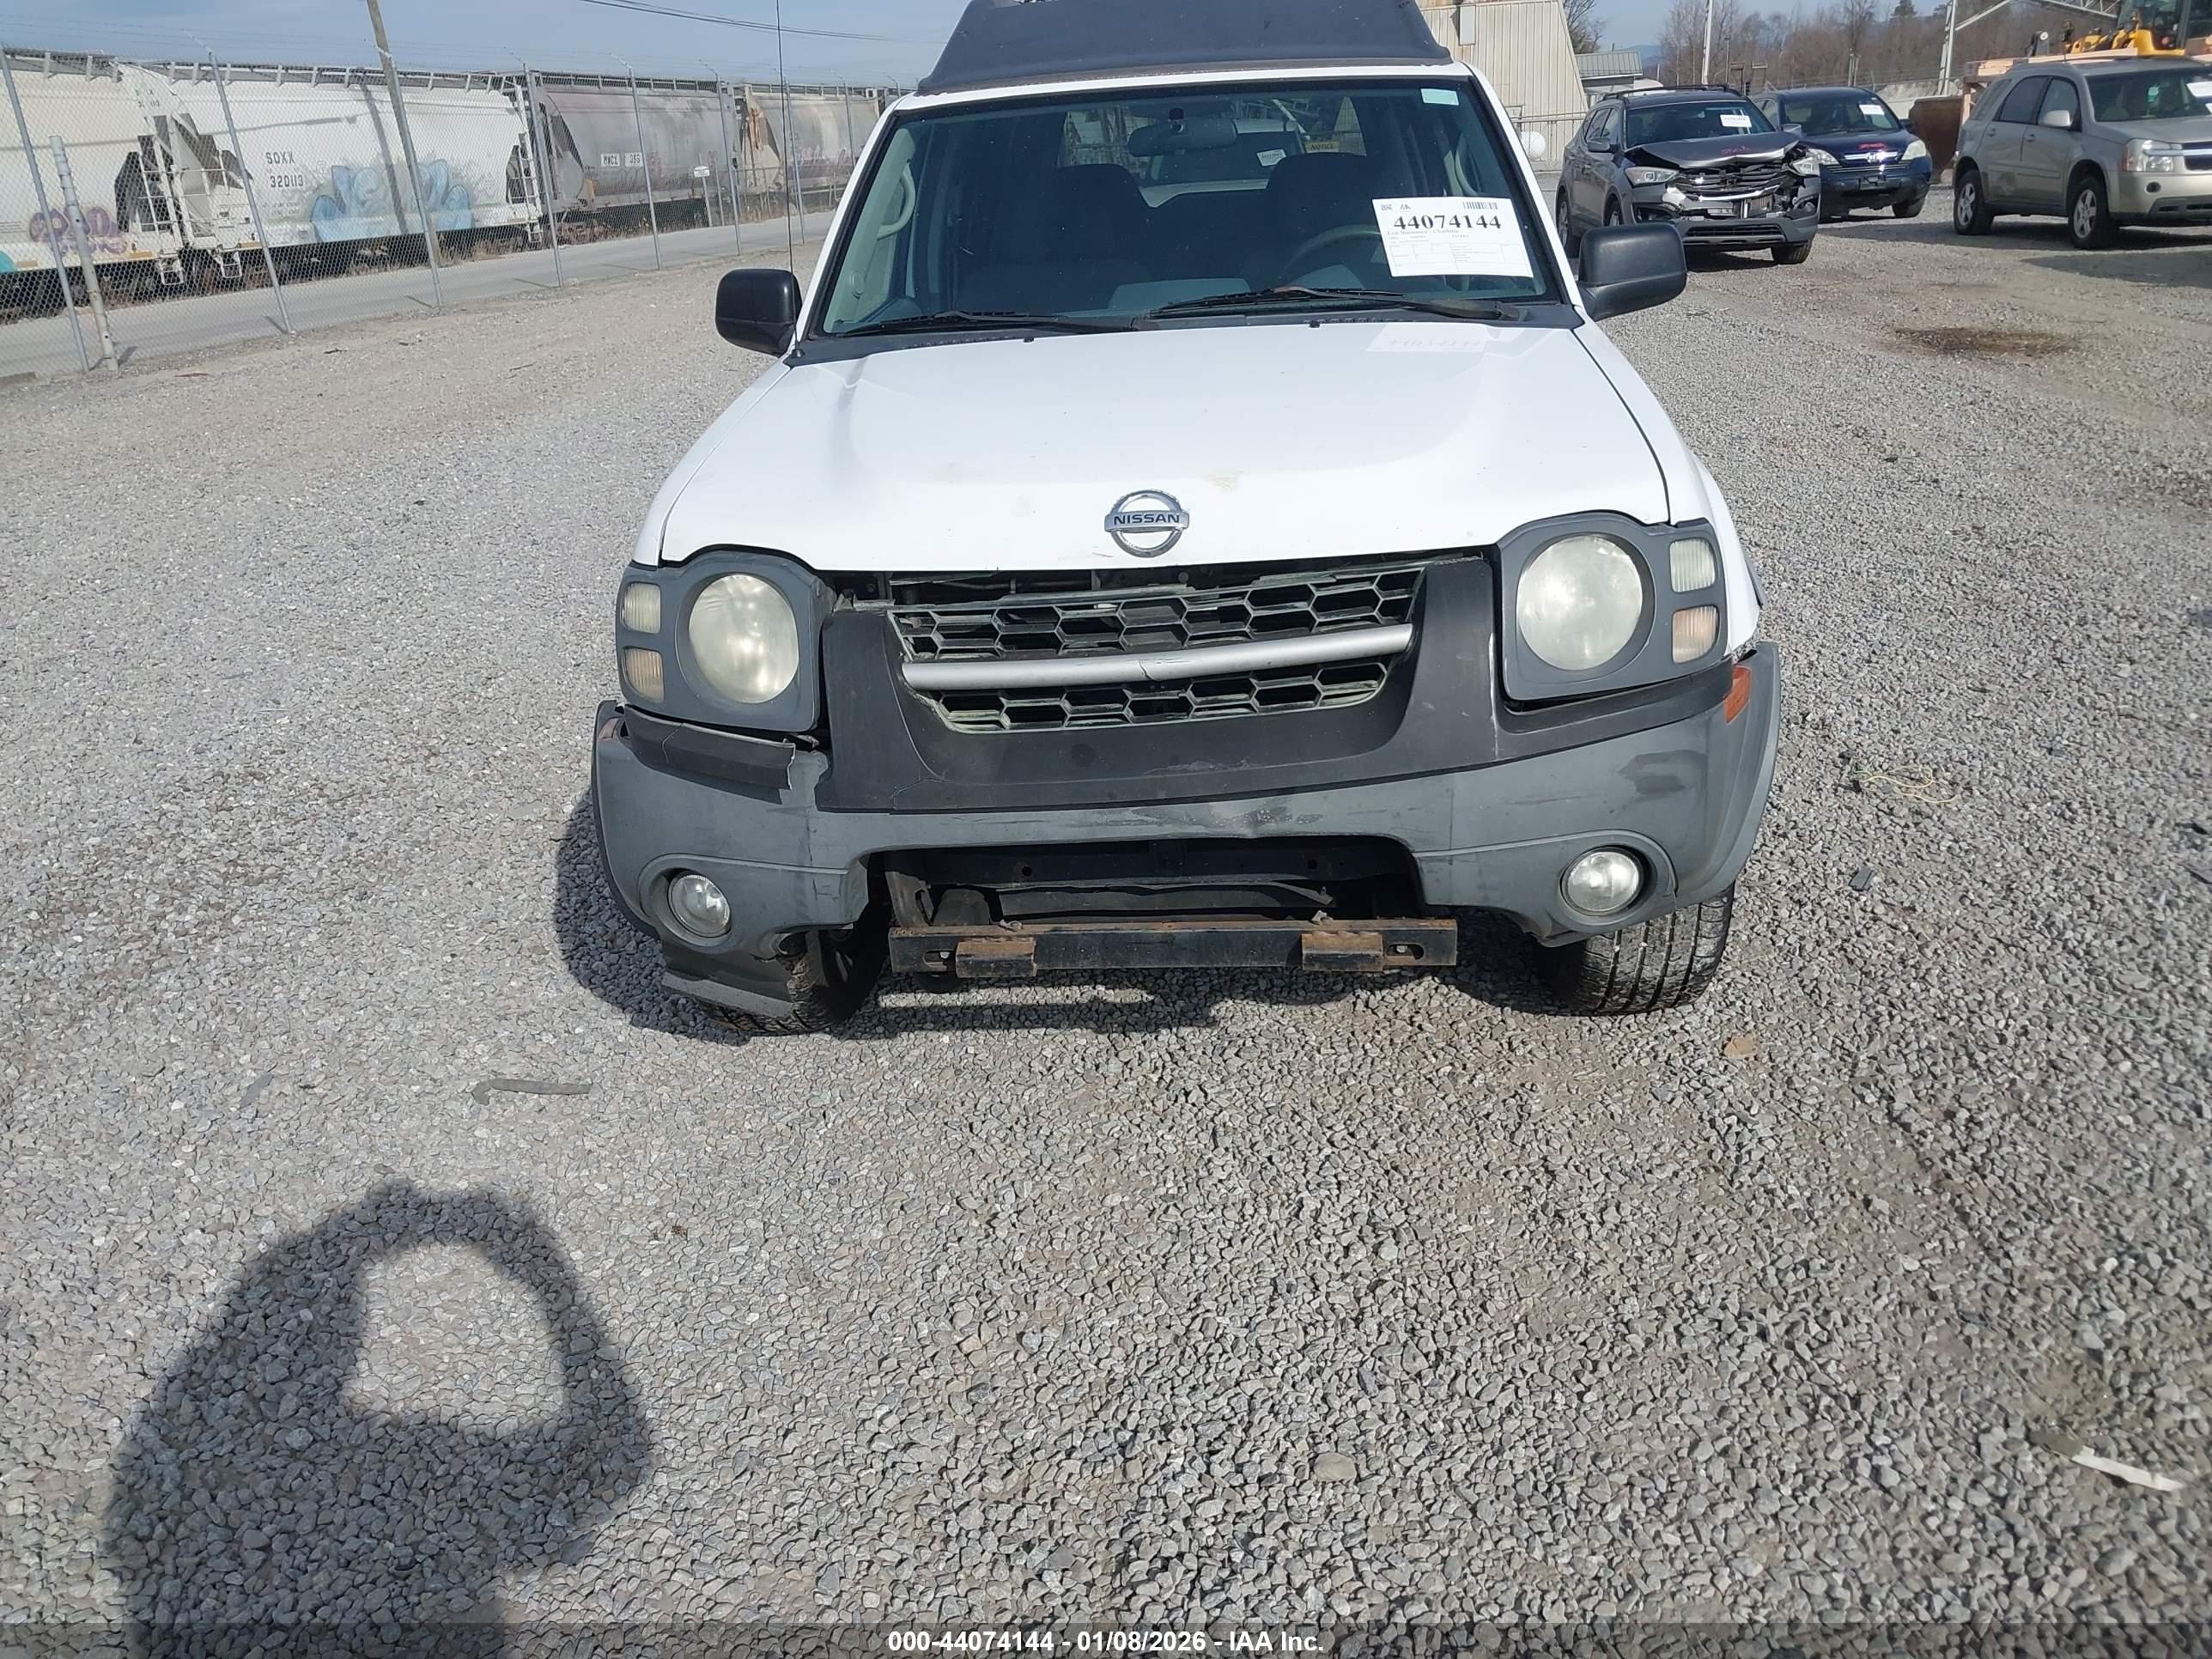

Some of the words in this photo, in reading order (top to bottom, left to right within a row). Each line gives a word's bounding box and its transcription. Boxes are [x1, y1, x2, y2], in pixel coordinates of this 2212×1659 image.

[265, 150, 295, 165] SOXX
[270, 174, 304, 187] 320113
[1394, 215, 1502, 229] 44074144
[1114, 514, 1180, 525] NISSAN
